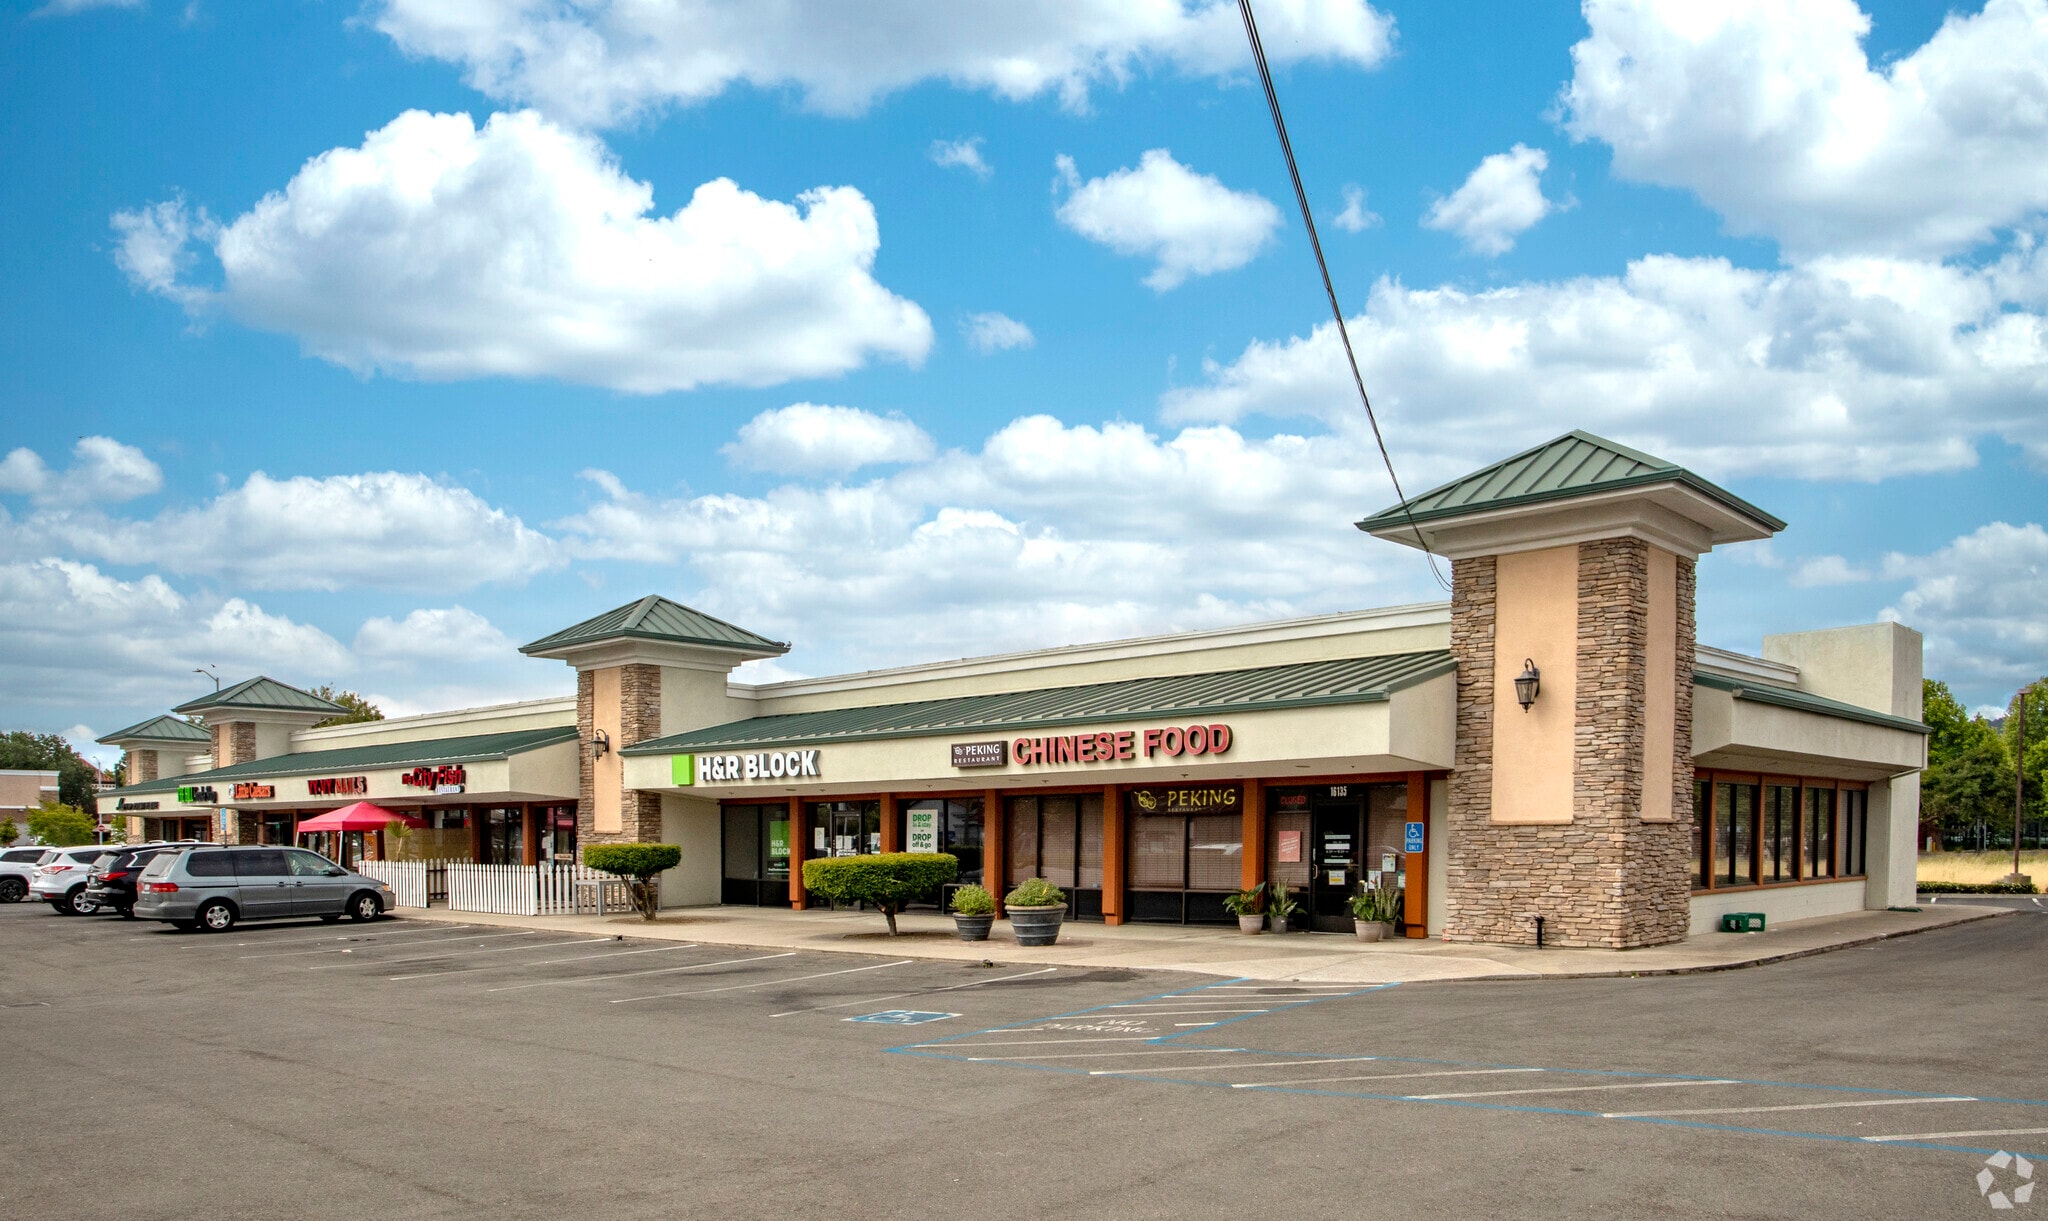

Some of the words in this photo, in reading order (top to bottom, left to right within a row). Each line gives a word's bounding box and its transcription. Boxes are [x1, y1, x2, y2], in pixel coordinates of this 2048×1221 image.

[965, 744, 1000, 756] PEKING
[1012, 731, 1134, 765] CHINESE
[1144, 724, 1233, 757] FOOD
[699, 755, 743, 780] H&R
[745, 750, 819, 778] BLOCK
[413, 767, 437, 790] City
[438, 765, 465, 785] Fish
[335, 776, 367, 795] NAILS
[1330, 786, 1347, 797] 16135
[1167, 789, 1236, 806] PEKING
[771, 840, 784, 848] H&R
[912, 833, 932, 841] DROP
[1034, 1023, 1160, 1033] PARKING
